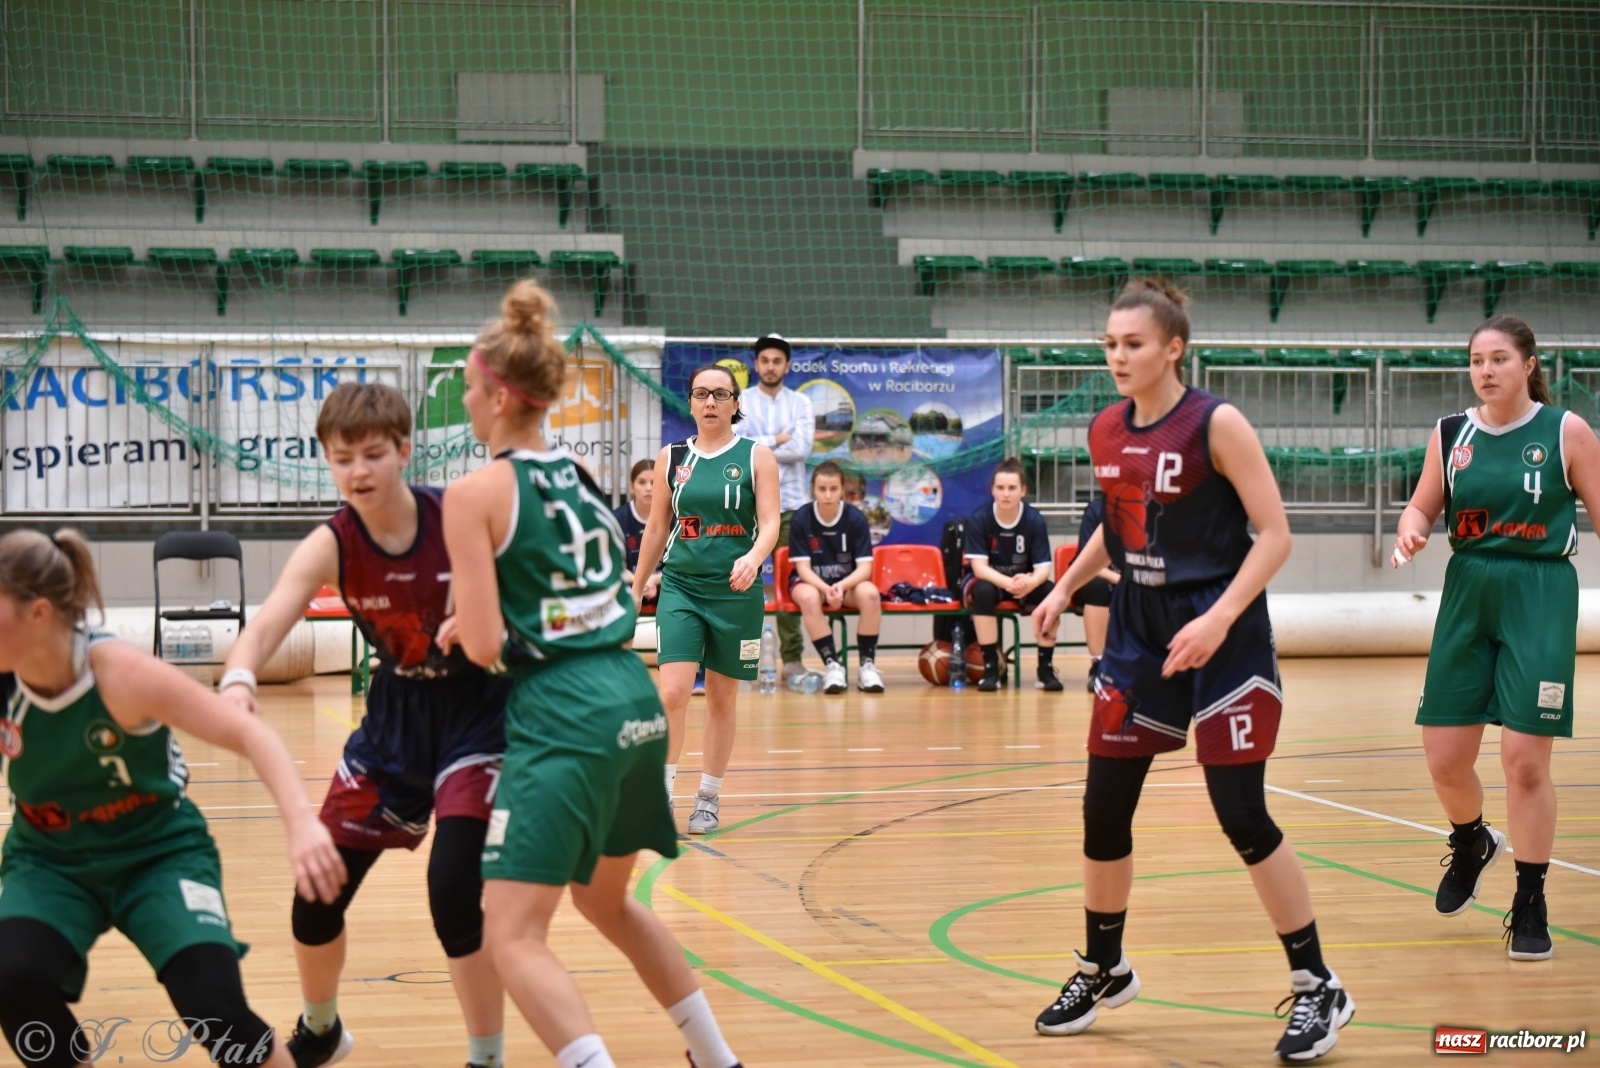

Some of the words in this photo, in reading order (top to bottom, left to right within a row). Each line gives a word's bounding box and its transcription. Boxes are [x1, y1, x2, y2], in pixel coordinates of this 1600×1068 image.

[790, 360, 828, 373] odek
[831, 360, 877, 376] Sportu
[881, 361, 887, 373] i
[889, 361, 955, 377] Rekreacji
[868, 381, 882, 392] w
[886, 379, 955, 393] Raciborzu
[236, 435, 319, 471] gra
[1155, 452, 1182, 493] 12
[724, 483, 741, 510] 11
[1523, 470, 1542, 505] 4
[1015, 534, 1025, 554] 8
[1491, 521, 1547, 540] KAMAN
[1229, 714, 1254, 750] 12
